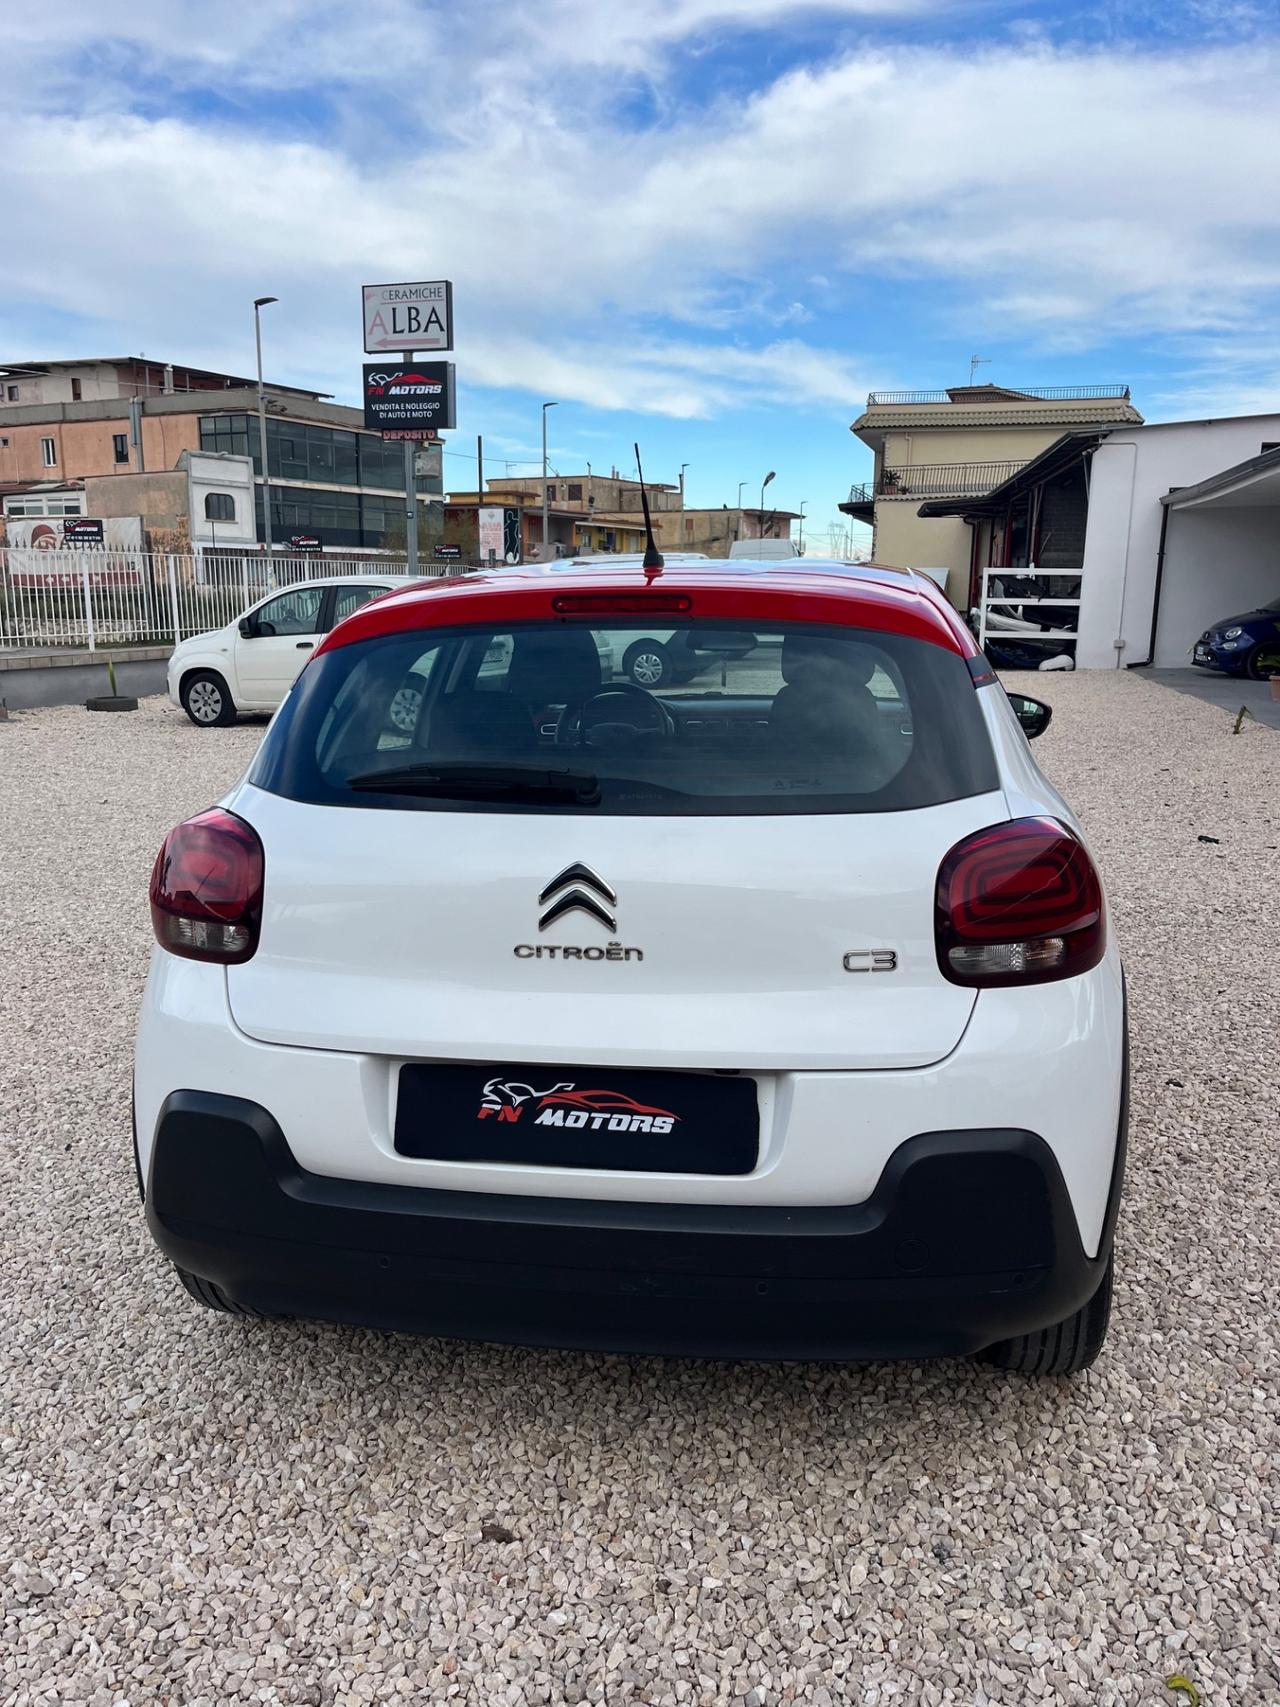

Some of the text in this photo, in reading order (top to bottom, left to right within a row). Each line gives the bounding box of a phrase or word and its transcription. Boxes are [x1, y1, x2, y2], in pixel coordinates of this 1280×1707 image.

[381, 287, 443, 301] CERAMICHE
[368, 306, 445, 335] ALBA
[368, 384, 443, 395] FN MOTORS
[371, 402, 400, 411] VENDITA
[405, 402, 440, 410] NOLEGGIO
[383, 430, 435, 440] DEPOSITO
[843, 949, 898, 973] C3
[477, 1103, 675, 1134] FN MOTORS
